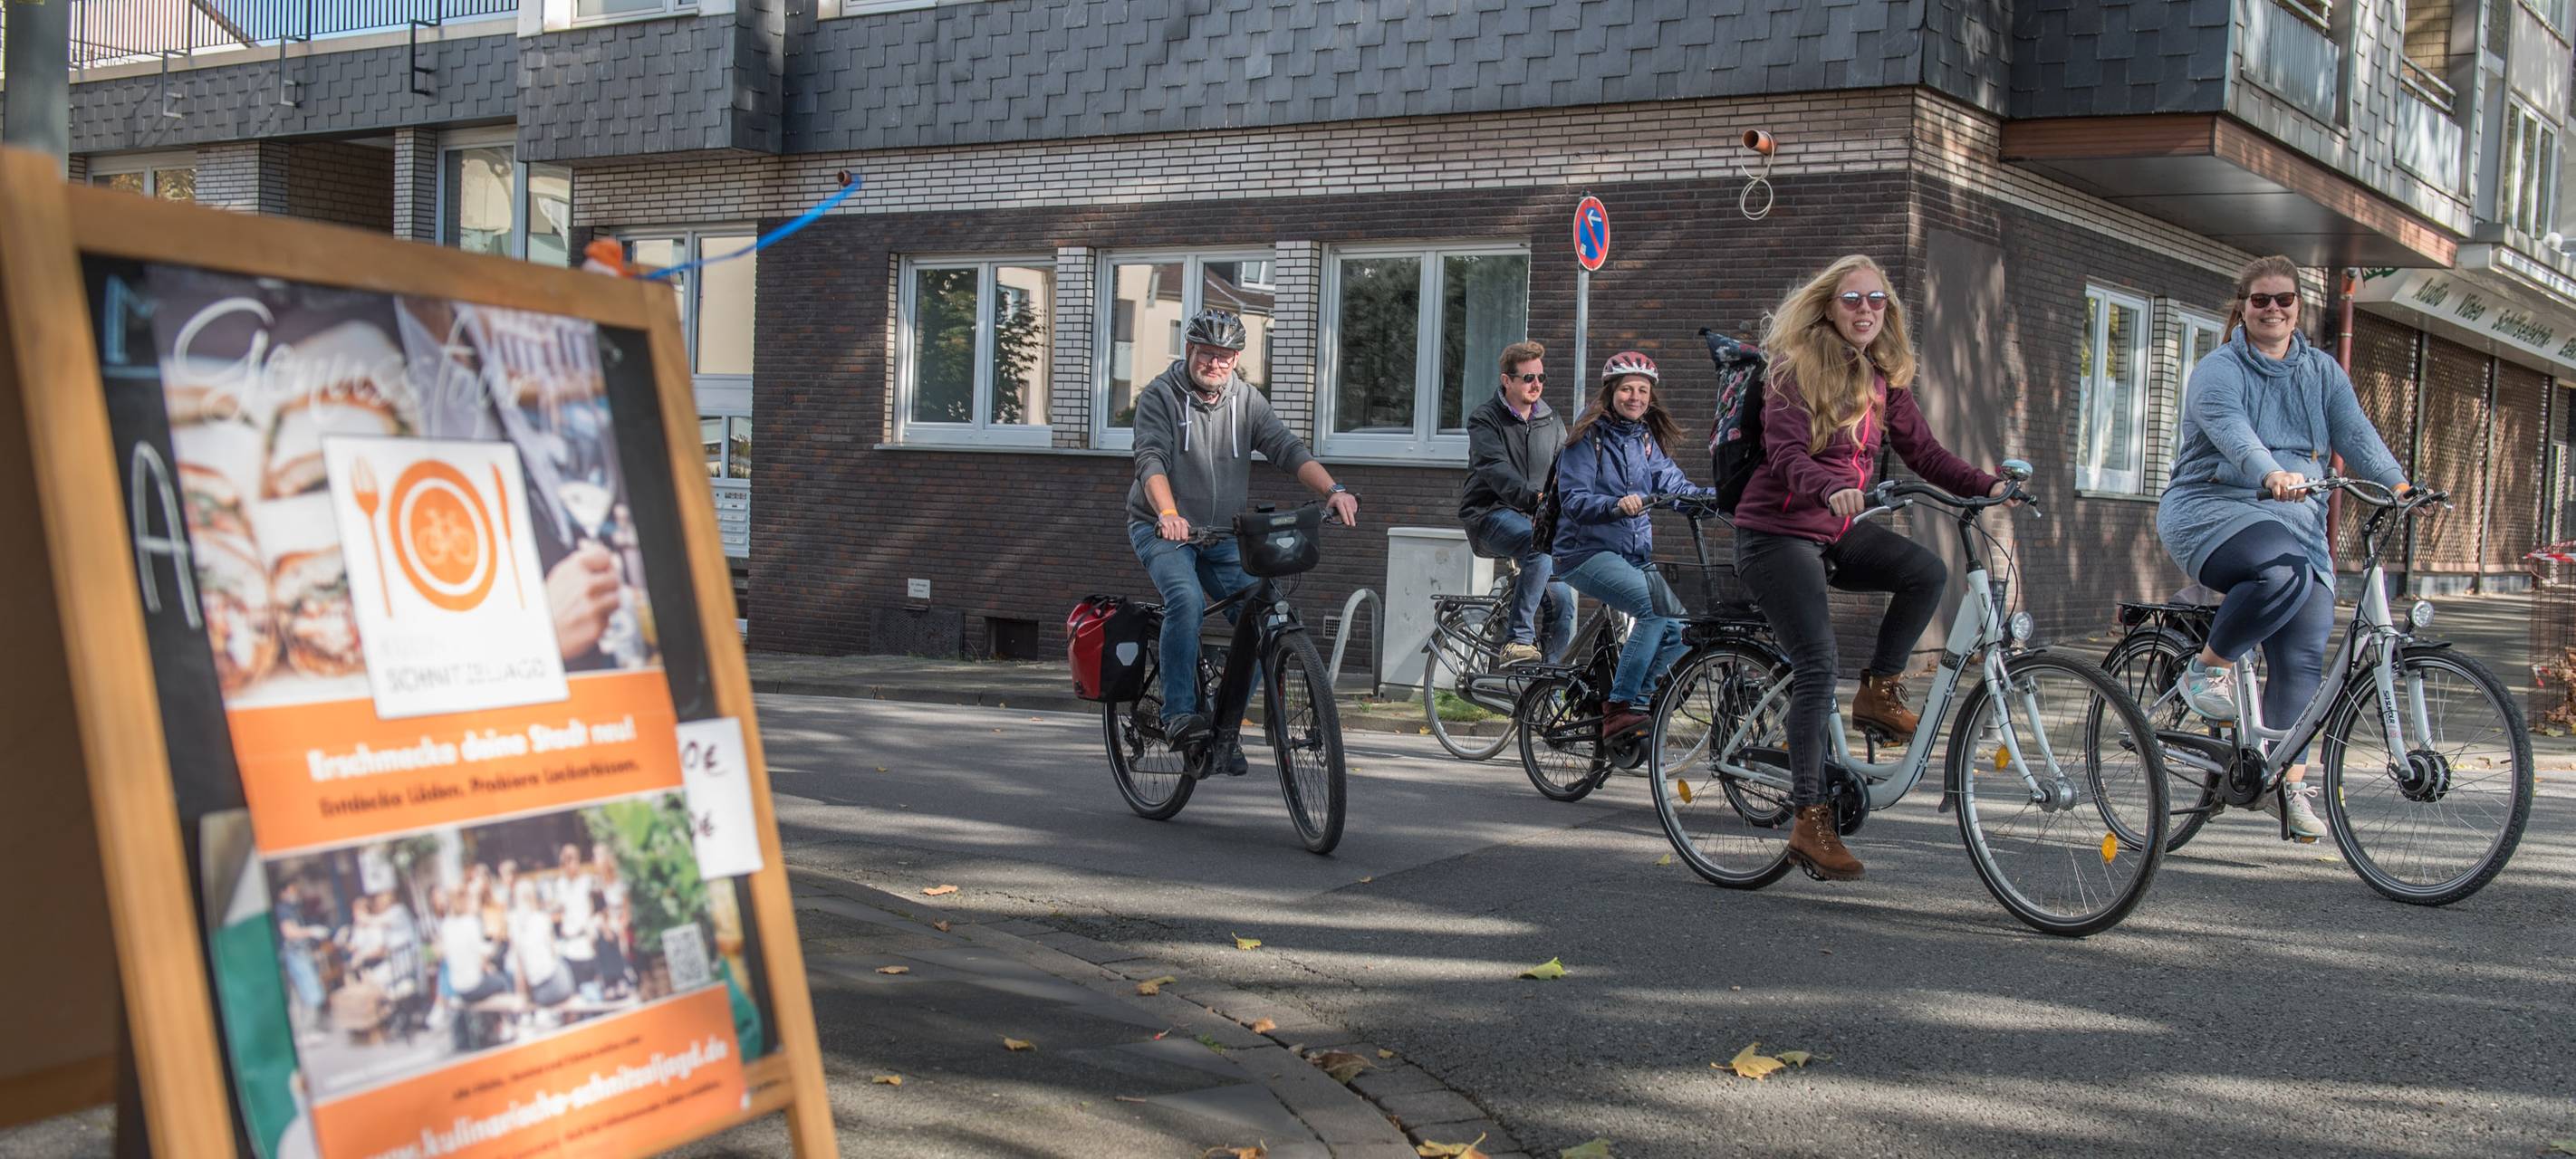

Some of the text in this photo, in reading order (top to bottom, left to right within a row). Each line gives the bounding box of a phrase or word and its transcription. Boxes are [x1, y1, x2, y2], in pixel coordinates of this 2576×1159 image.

[460, 728, 528, 763] deine
[528, 717, 589, 754] Stadt
[362, 1035, 729, 1159] w.kulinarische-schnitzeljagd.de
